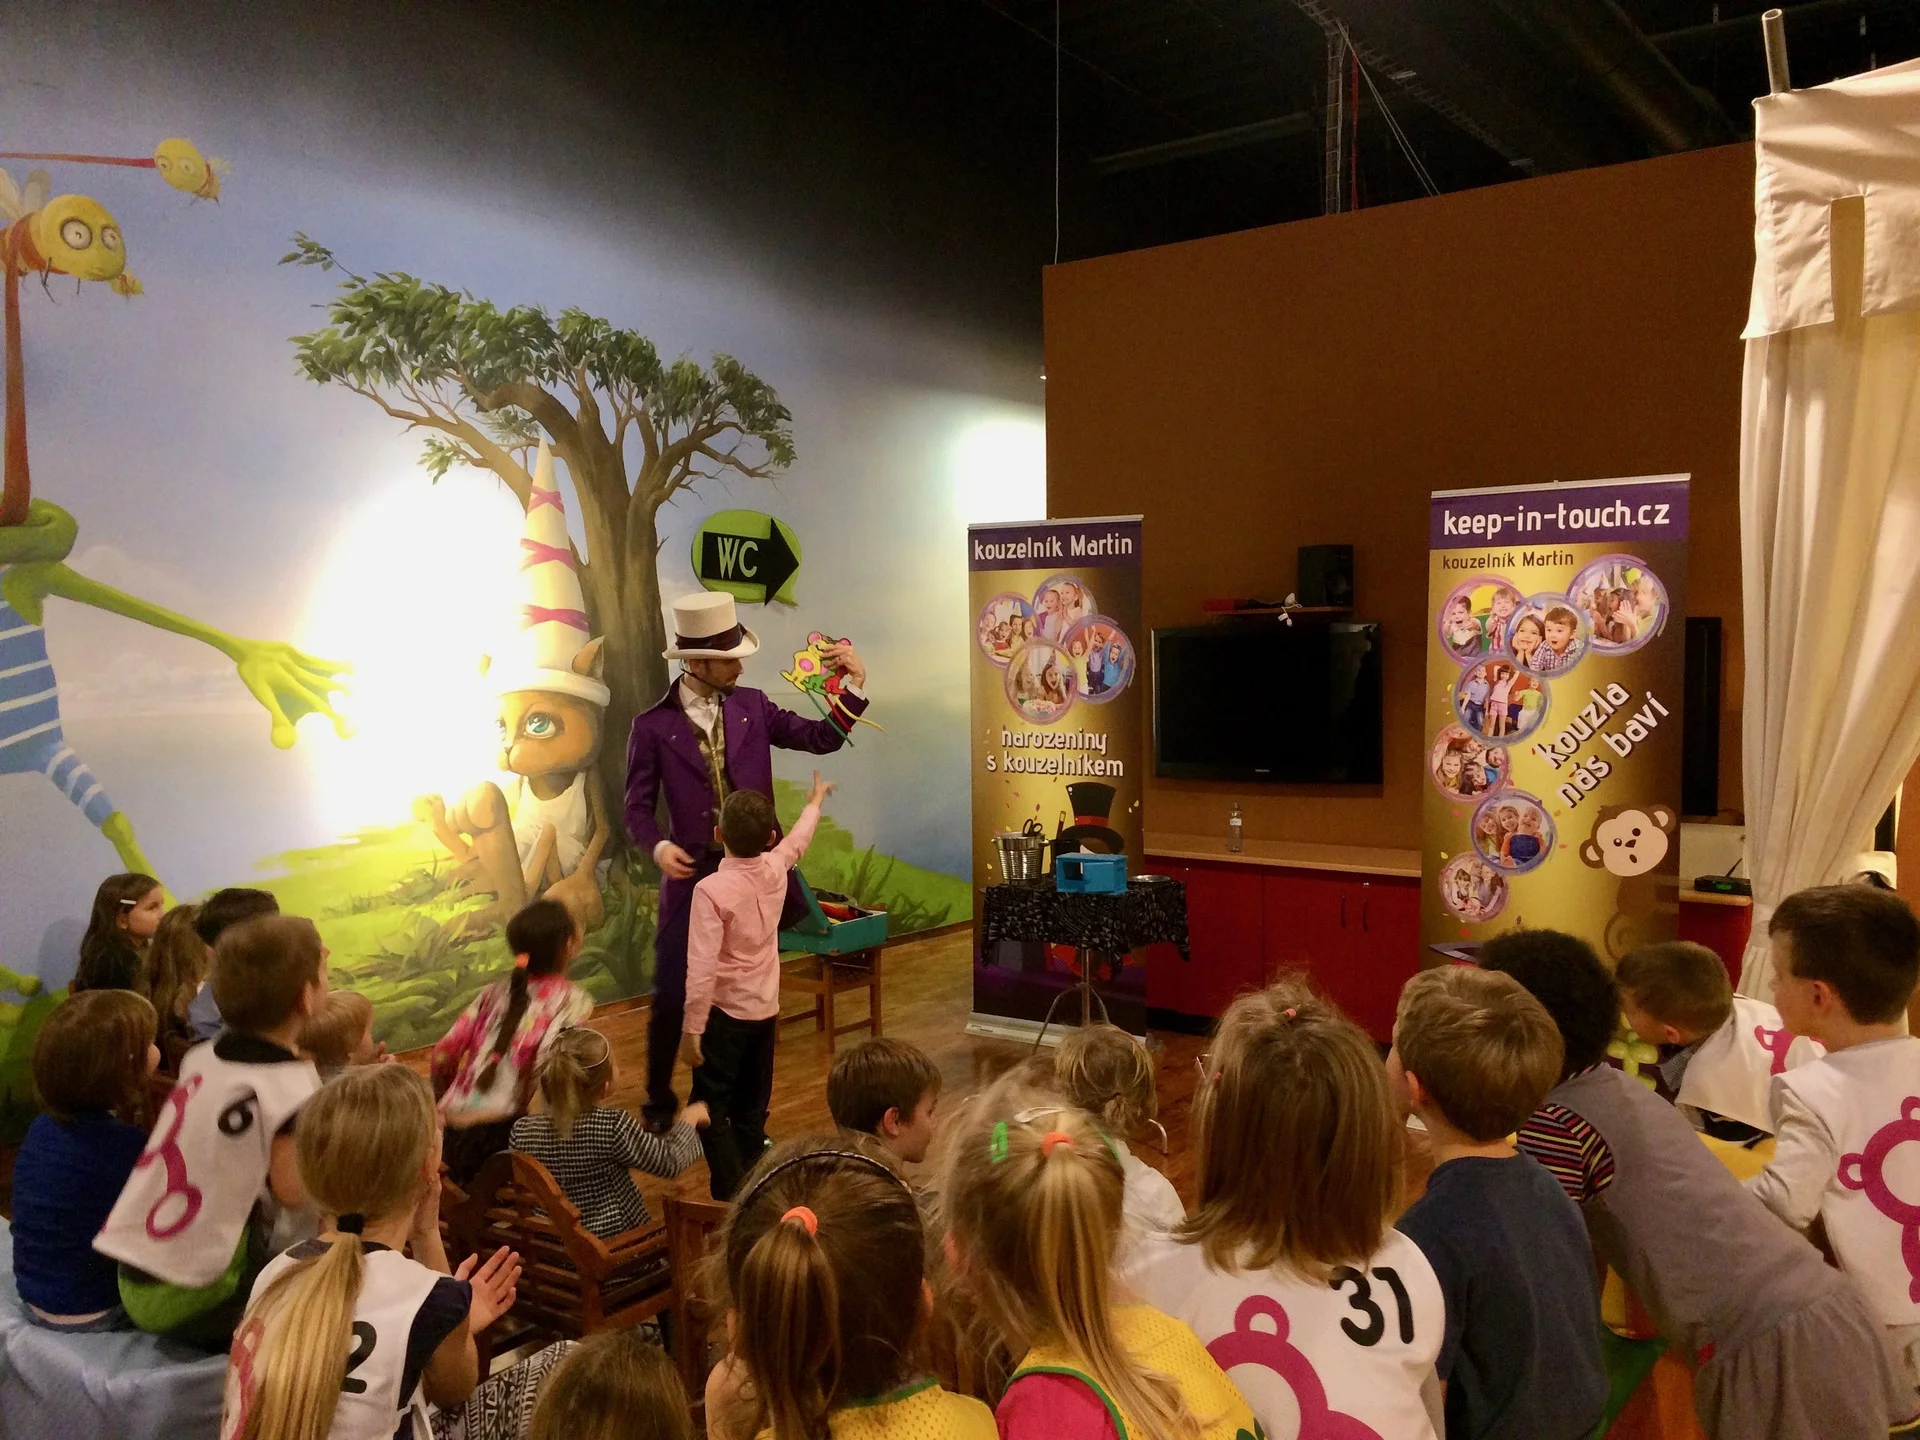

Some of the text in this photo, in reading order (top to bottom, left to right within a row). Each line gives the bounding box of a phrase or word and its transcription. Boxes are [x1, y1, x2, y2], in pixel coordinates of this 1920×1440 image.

[1444, 500, 1670, 539] keep-in-touch.cz
[717, 536, 758, 579] WC
[974, 533, 1133, 560] kouzelník Martin
[1442, 551, 1574, 570] kouzelník Martin
[1001, 728, 1107, 755] narozeniny
[1537, 681, 1630, 770] kouzla
[986, 752, 1124, 777] s kouzelníkem
[1555, 691, 1670, 809] nás baví
[1328, 1265, 1415, 1347] 31
